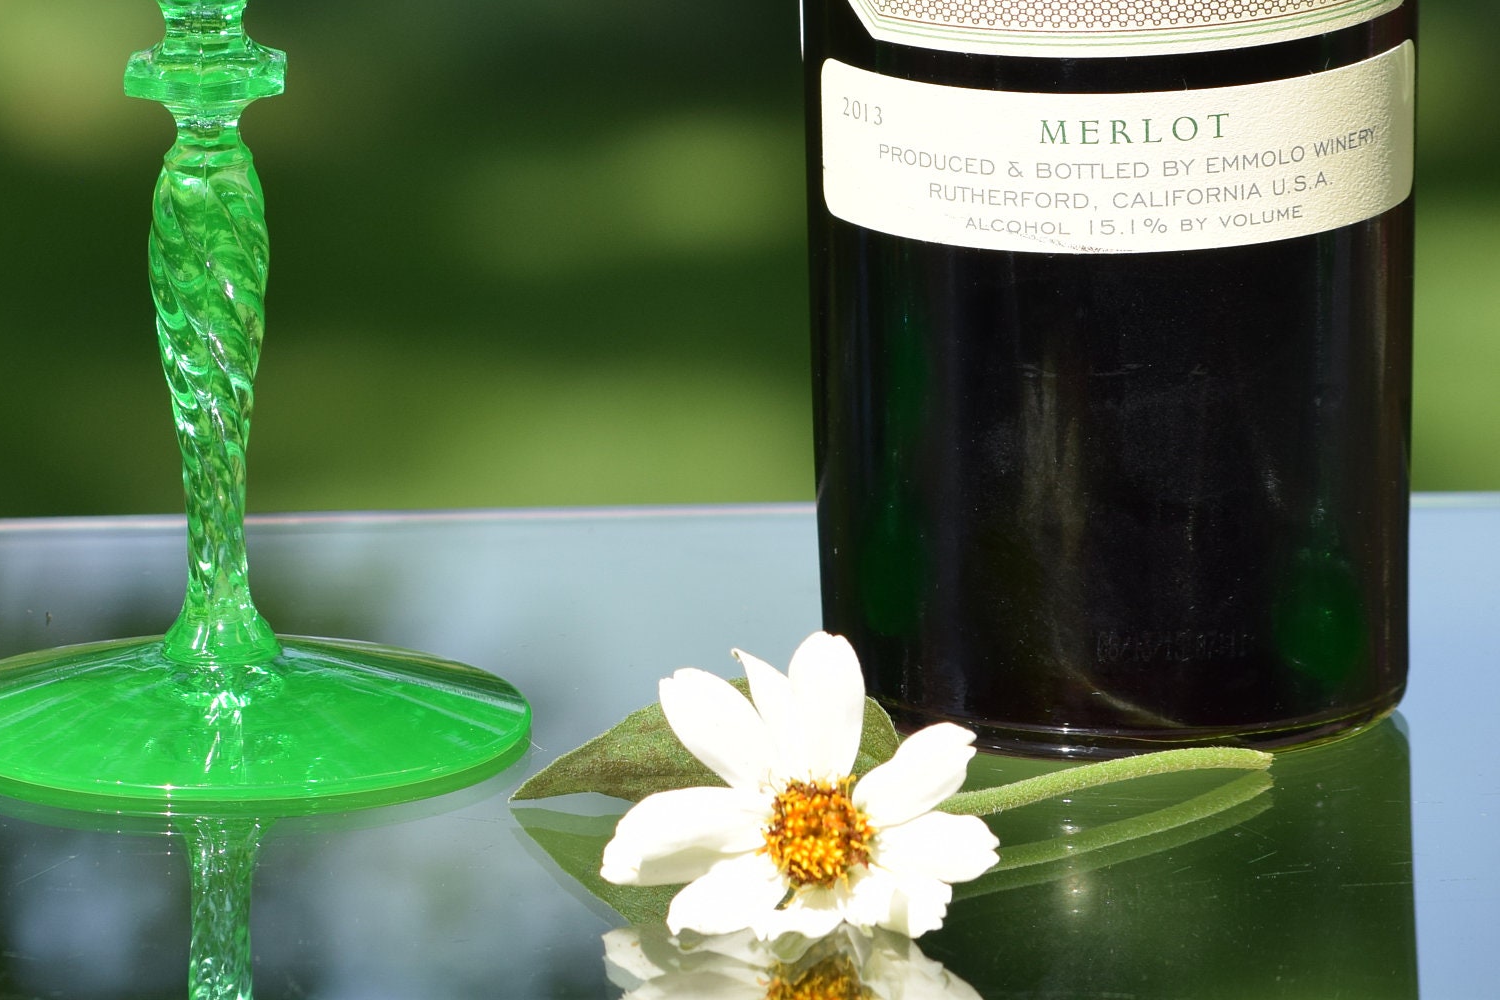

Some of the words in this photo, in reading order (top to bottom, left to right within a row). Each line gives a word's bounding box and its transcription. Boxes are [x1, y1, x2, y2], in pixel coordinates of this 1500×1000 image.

[842, 96, 885, 126] 2013
[1038, 113, 1230, 146] MERLOT
[878, 143, 996, 176] PRODUCED
[1007, 160, 1025, 178] &
[1035, 162, 1150, 180] BOTTLED
[1162, 158, 1196, 177] BY
[1206, 145, 1306, 174] EMMOLO
[1313, 125, 1378, 158] WINERY
[928, 182, 1098, 211] RUTHERFORD,
[1112, 182, 1263, 210] CALIFORNIA
[1272, 170, 1334, 196] U.S.A.
[964, 216, 1071, 236] ALCOHOL
[1088, 217, 1169, 236] 15.1%
[1180, 217, 1208, 232] BY
[1218, 204, 1304, 229] VOLUME
